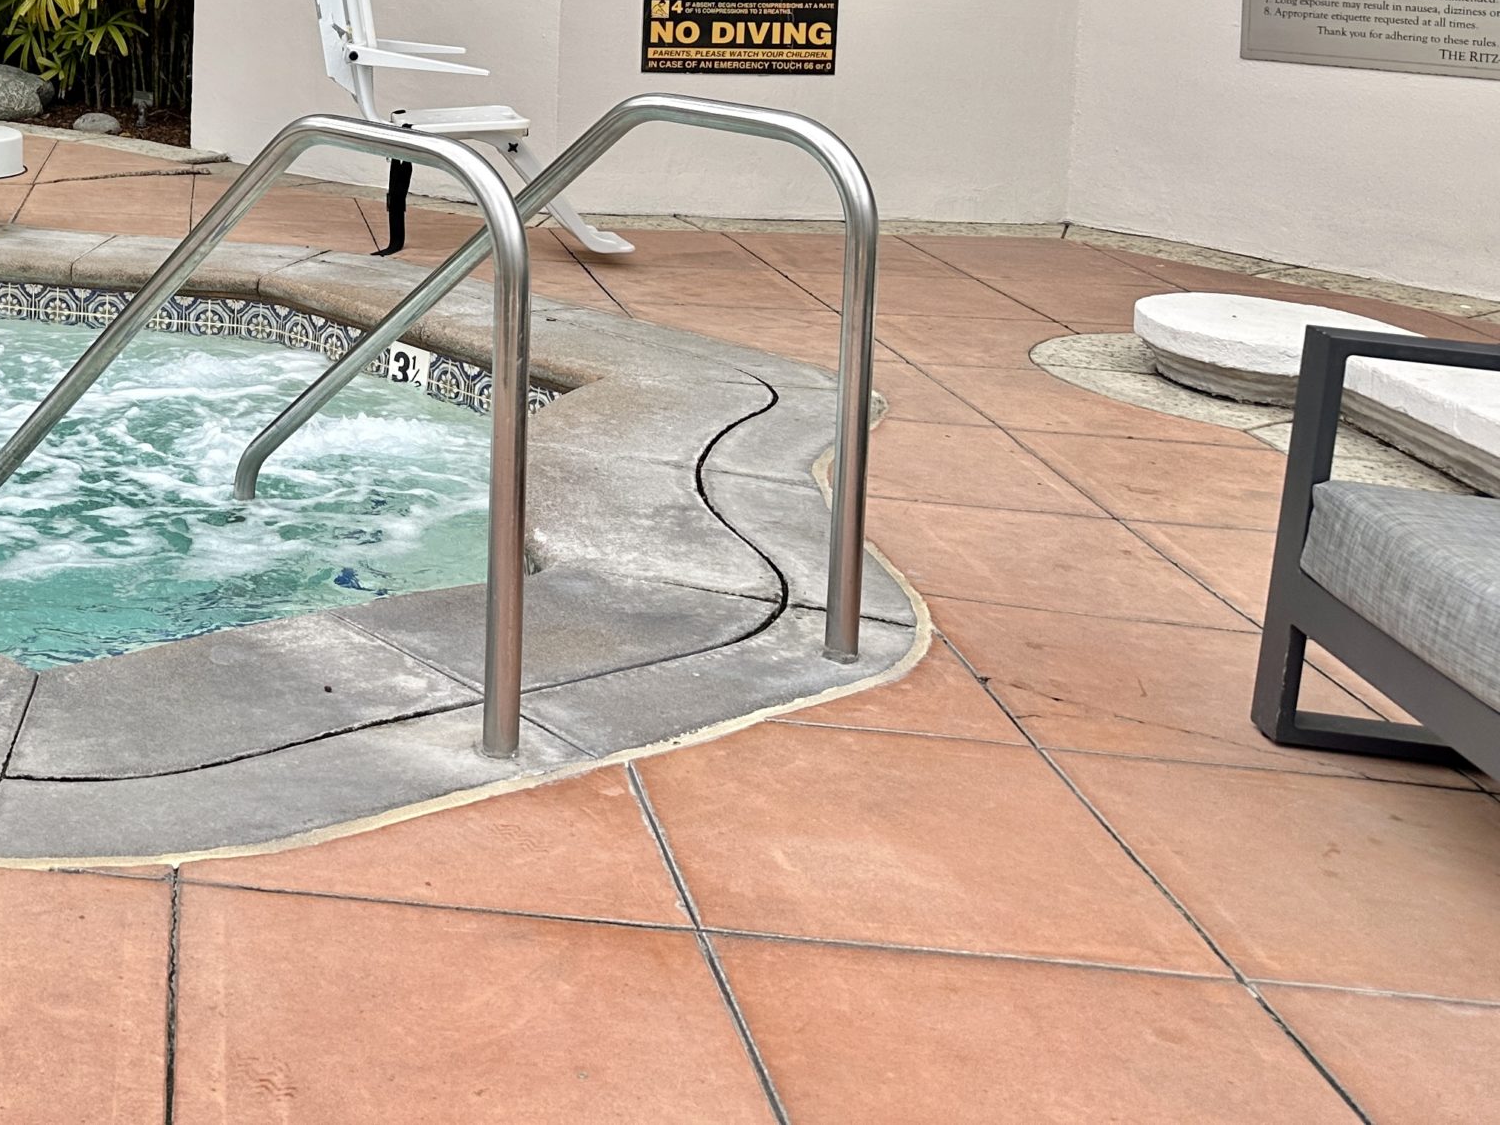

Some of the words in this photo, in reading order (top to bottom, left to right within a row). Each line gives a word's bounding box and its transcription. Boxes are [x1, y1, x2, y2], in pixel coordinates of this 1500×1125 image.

[672, 0, 683, 14] 4
[1300, 0, 1340, 8] exposure
[1342, 1, 1361, 10] may
[1364, 1, 1389, 11] result
[1405, 5, 1440, 14] nausea,
[1444, 5, 1486, 17] dizziness
[1275, 8, 1328, 20] Appropriate
[1331, 13, 1371, 23] etiquette
[1374, 16, 1419, 26] requested
[1422, 19, 1432, 27] at
[1434, 17, 1446, 27] all
[650, 21, 700, 44] NO
[712, 22, 832, 45] DIVING
[1317, 26, 1347, 36] Thank
[1369, 30, 1382, 39] for
[1385, 31, 1428, 44] adhering
[1444, 35, 1469, 45] these
[1439, 49, 1466, 61] THE
[699, 61, 712, 69] AN
[714, 61, 770, 69] EMERGENCY
[392, 351, 410, 383] 3
